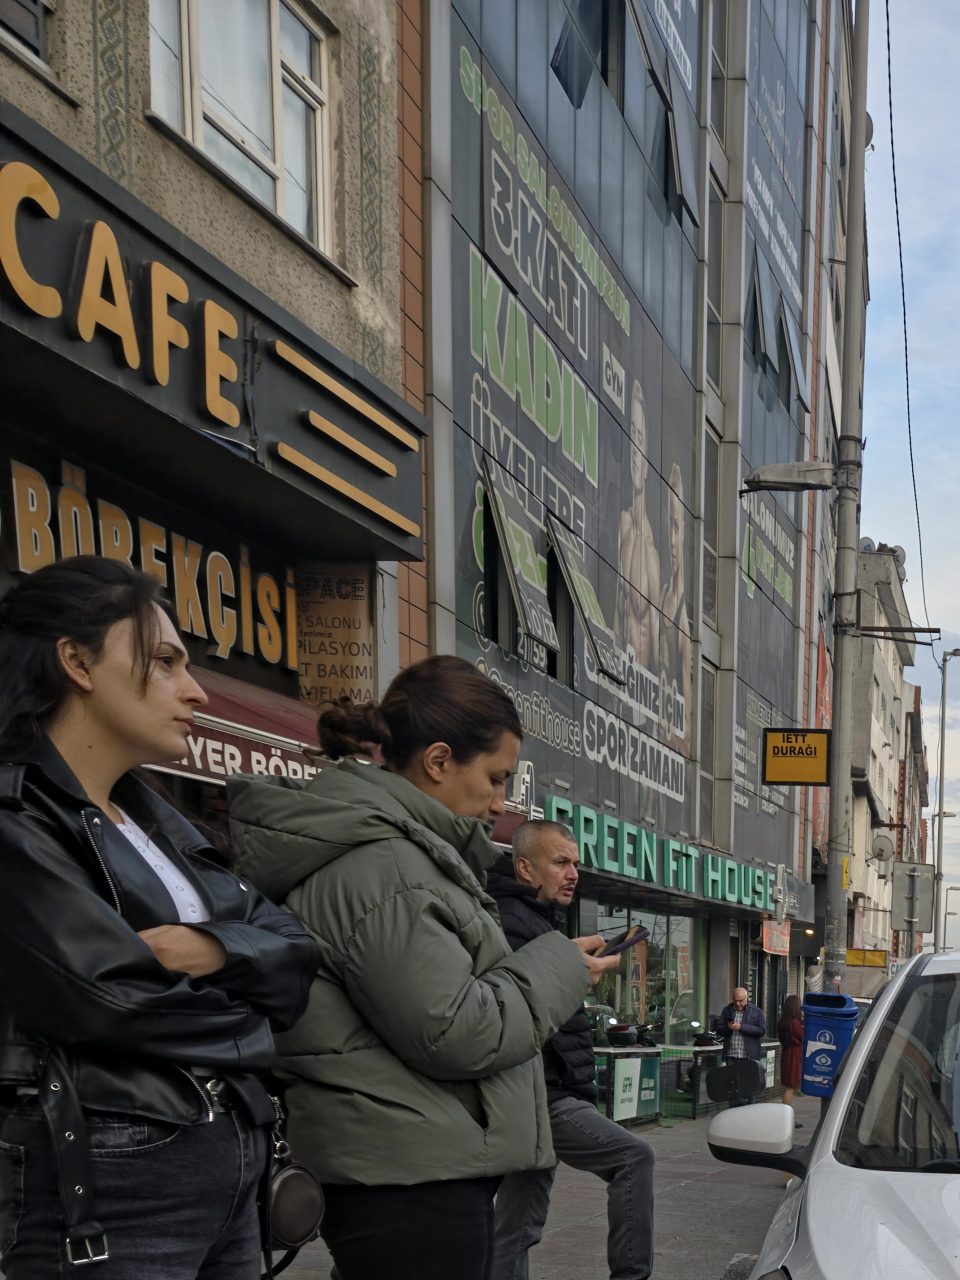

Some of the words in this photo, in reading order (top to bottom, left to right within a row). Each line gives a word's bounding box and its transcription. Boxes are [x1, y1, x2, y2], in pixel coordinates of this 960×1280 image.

[459, 45, 516, 166] SPOR
[0, 160, 241, 429] CAFE
[469, 242, 599, 489] KADIN
[10, 458, 299, 672] BÖREKÇİSİ
[306, 615, 362, 630] SALONU
[317, 663, 373, 681] BAKIMI
[250, 747, 323, 782] BÖRE
[583, 700, 629, 776] SPOR
[628, 725, 686, 804] ZAMANI
[772, 744, 817, 757] DURAĞI
[544, 795, 658, 883] GREEN
[702, 852, 777, 912] HOUSE
